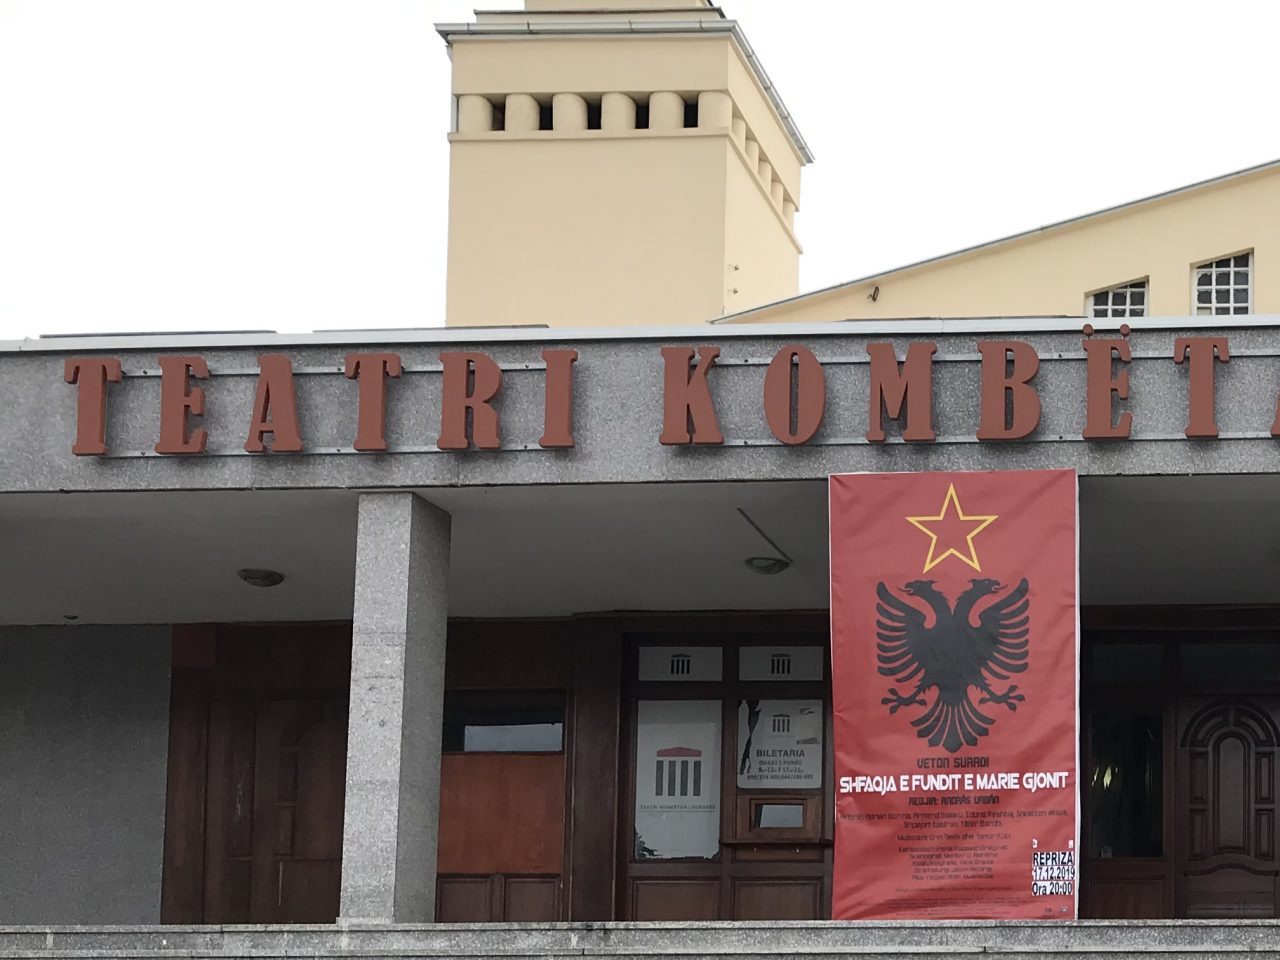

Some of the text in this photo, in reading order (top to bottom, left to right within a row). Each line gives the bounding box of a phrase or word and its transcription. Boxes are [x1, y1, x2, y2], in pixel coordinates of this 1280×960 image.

[64, 348, 578, 456] TEATRI
[840, 772, 1069, 796] SHFAQJA E FUNDIT E MARIE GJONIT
[1033, 852, 1073, 866] REPRIZA
[1034, 867, 1075, 879] 17.12.2019
[1032, 882, 1072, 895] Ora 20:00
